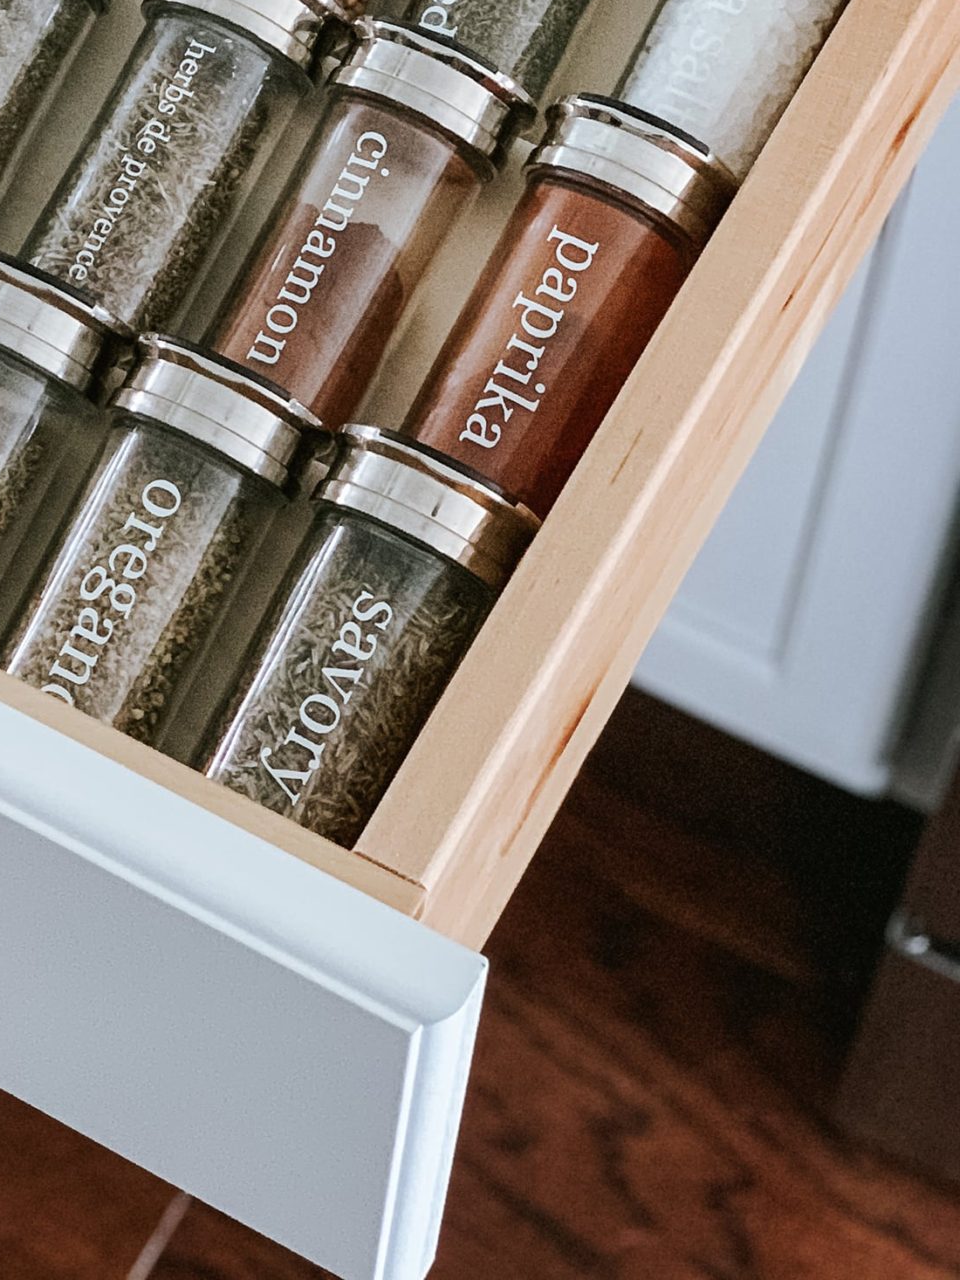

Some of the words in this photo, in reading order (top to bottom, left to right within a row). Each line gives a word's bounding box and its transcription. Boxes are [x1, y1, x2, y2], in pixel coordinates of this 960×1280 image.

[136, 117, 172, 155] de
[157, 38, 217, 116] herbs
[68, 154, 145, 281] provence
[246, 130, 390, 366] cinnamon
[458, 224, 600, 450] paprika
[259, 589, 394, 807] savory
